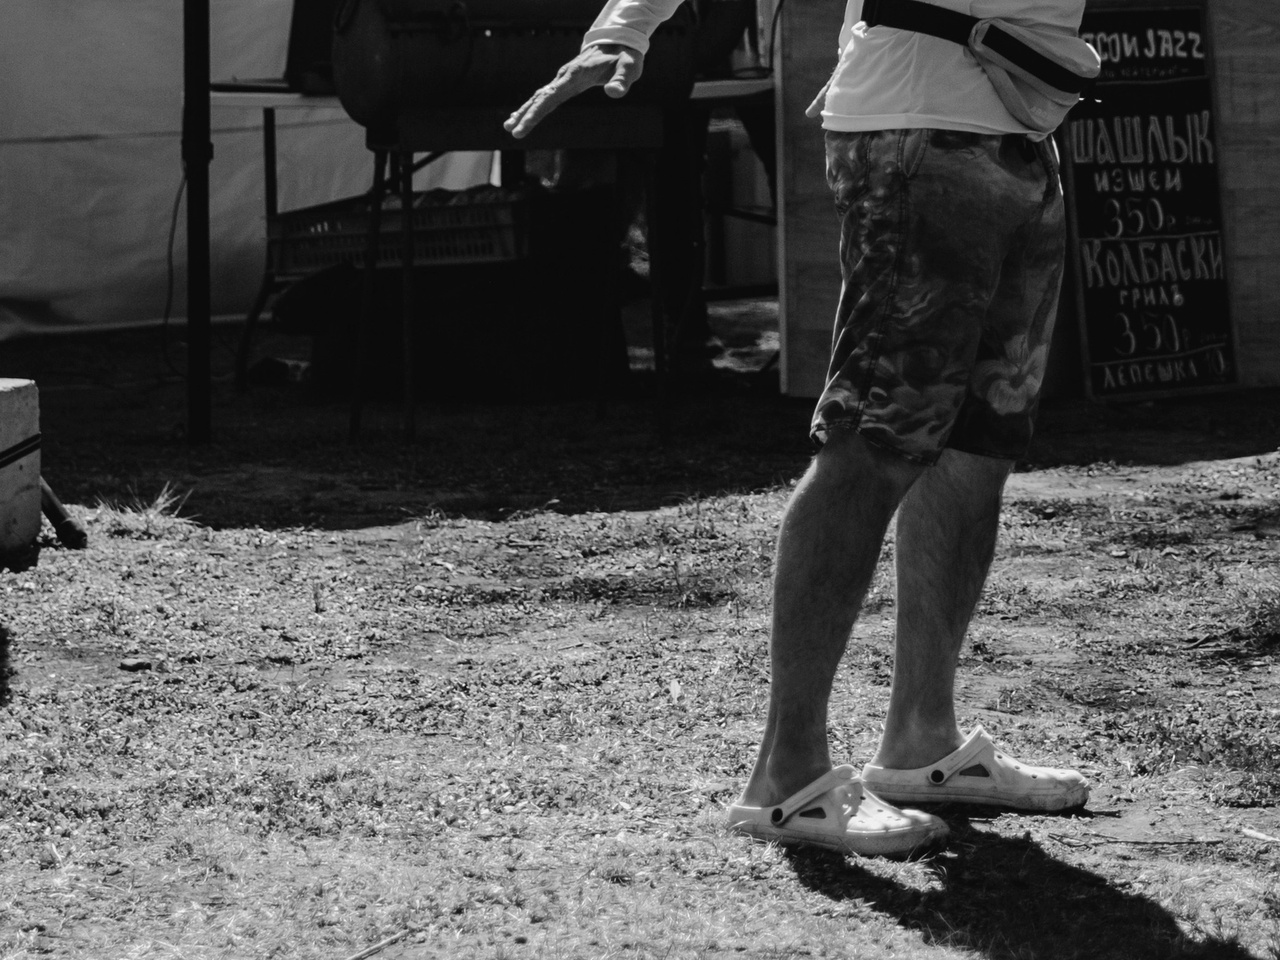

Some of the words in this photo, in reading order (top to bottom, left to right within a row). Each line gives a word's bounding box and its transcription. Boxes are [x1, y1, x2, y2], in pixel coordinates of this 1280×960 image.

[1144, 28, 1205, 59] JAZZ
[1070, 109, 1214, 165] ШАШЛЫК
[1081, 234, 1225, 289] КОЛБАСКИ
